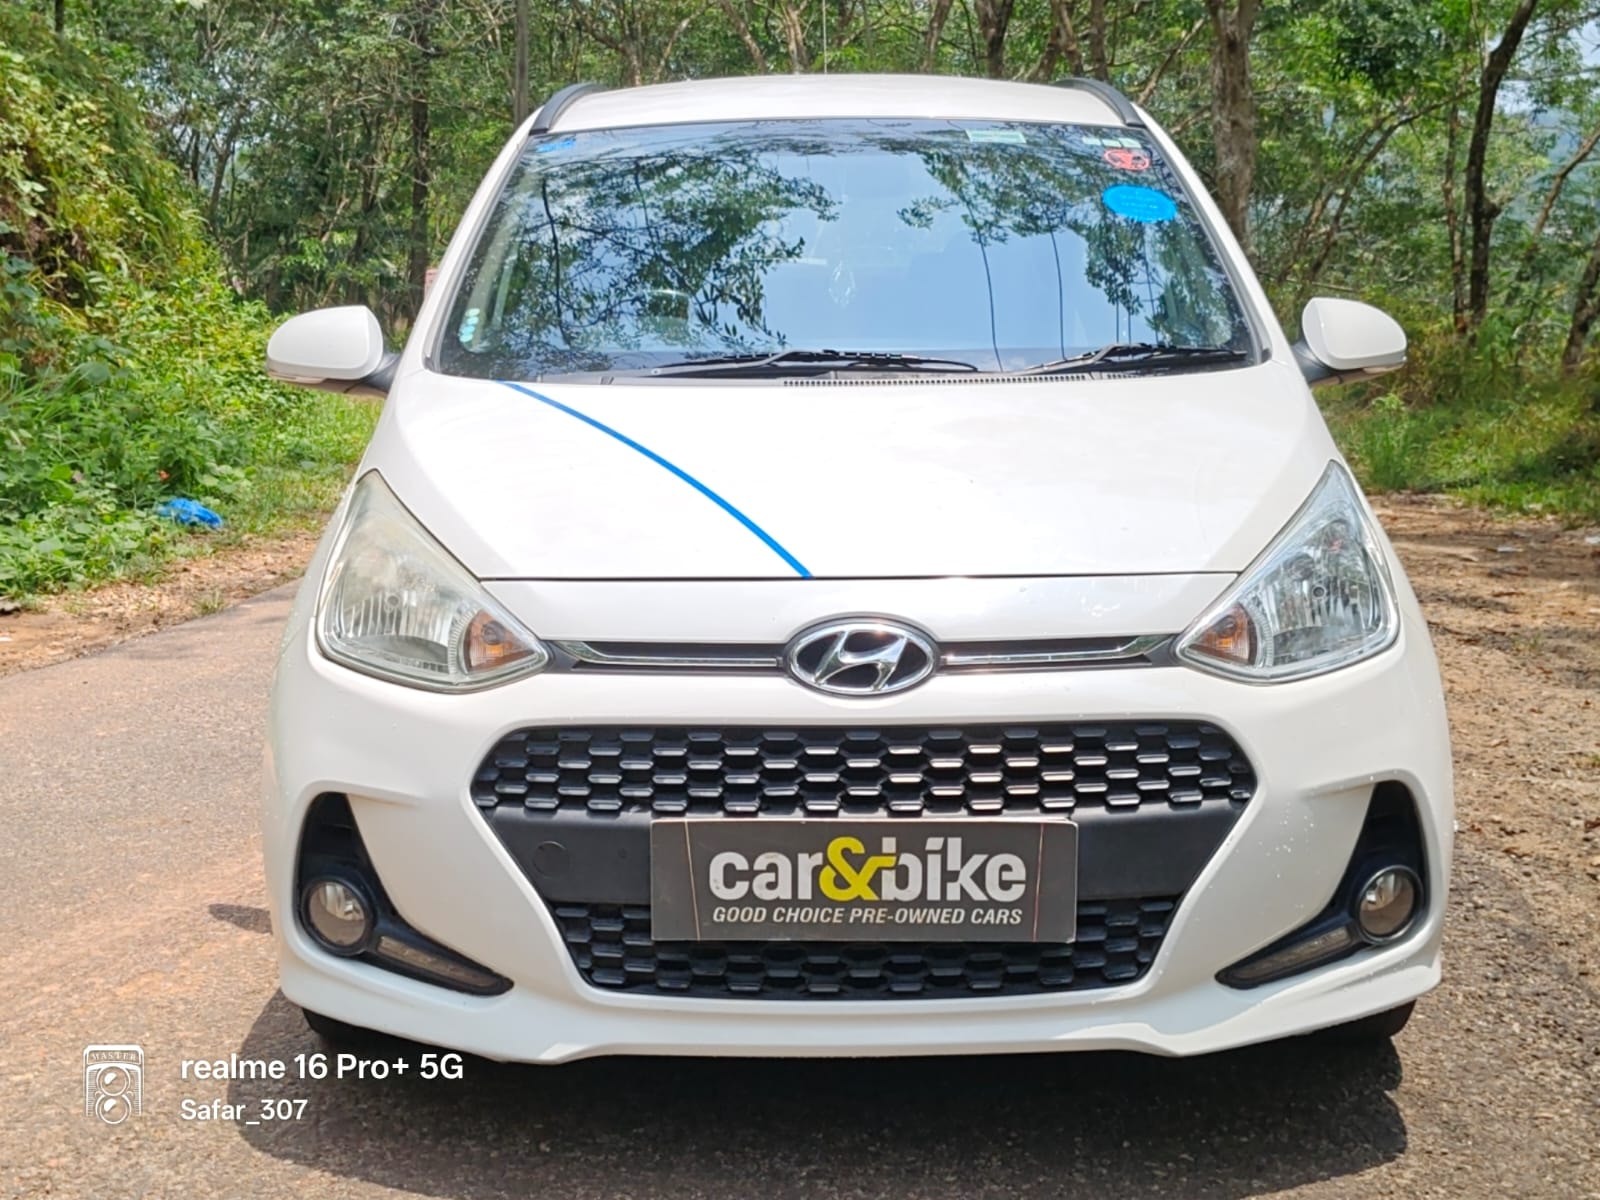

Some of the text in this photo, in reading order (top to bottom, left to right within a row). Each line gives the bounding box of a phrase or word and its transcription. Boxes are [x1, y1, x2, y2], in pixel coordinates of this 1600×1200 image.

[708, 836, 1027, 902] car&bike
[712, 906, 1022, 925] GOOD CHOICE PRE-OWNED CARS
